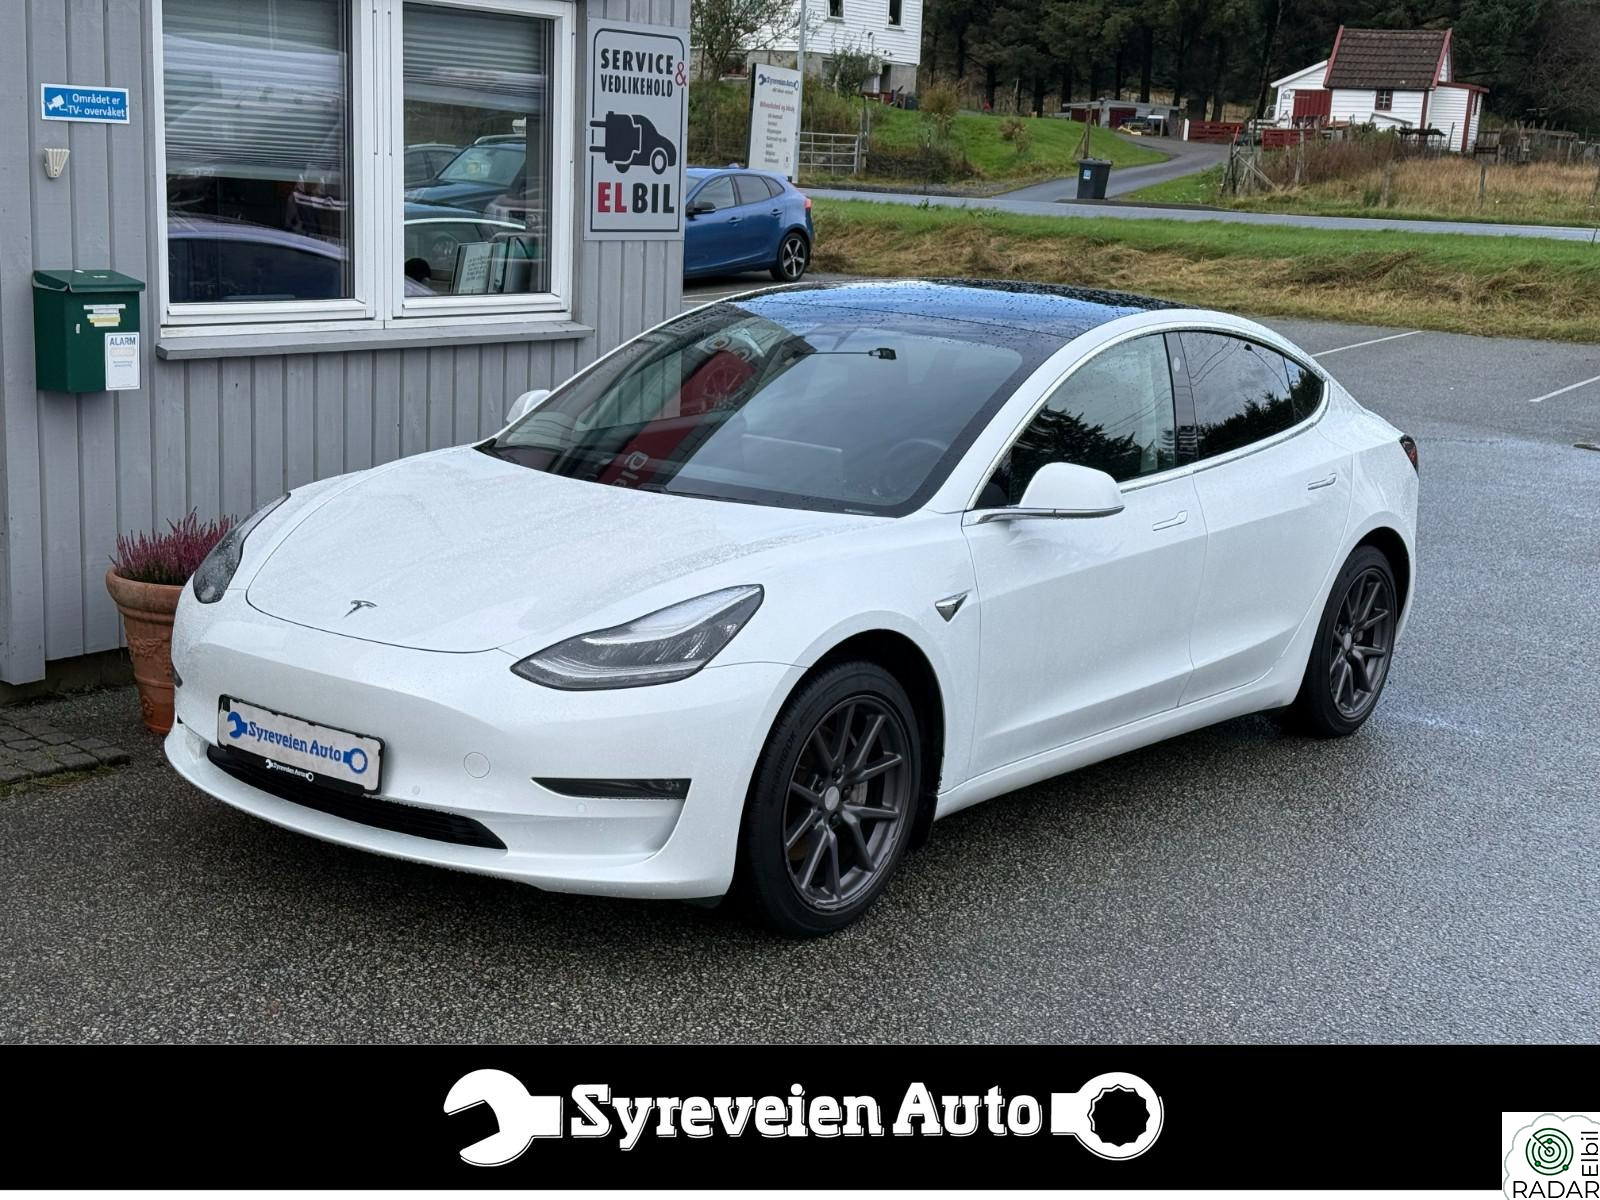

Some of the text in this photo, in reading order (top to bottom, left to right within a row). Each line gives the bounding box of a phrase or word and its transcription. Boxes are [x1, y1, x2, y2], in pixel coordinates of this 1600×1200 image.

[600, 48, 687, 87] SERVICE &
[600, 73, 673, 98] VEDLIKEHOLD
[72, 93, 110, 105] Området
[84, 106, 125, 117] overvåket
[598, 181, 675, 214] ELBIL
[109, 336, 136, 346] ALARM
[248, 721, 342, 762] Syreveien Auto
